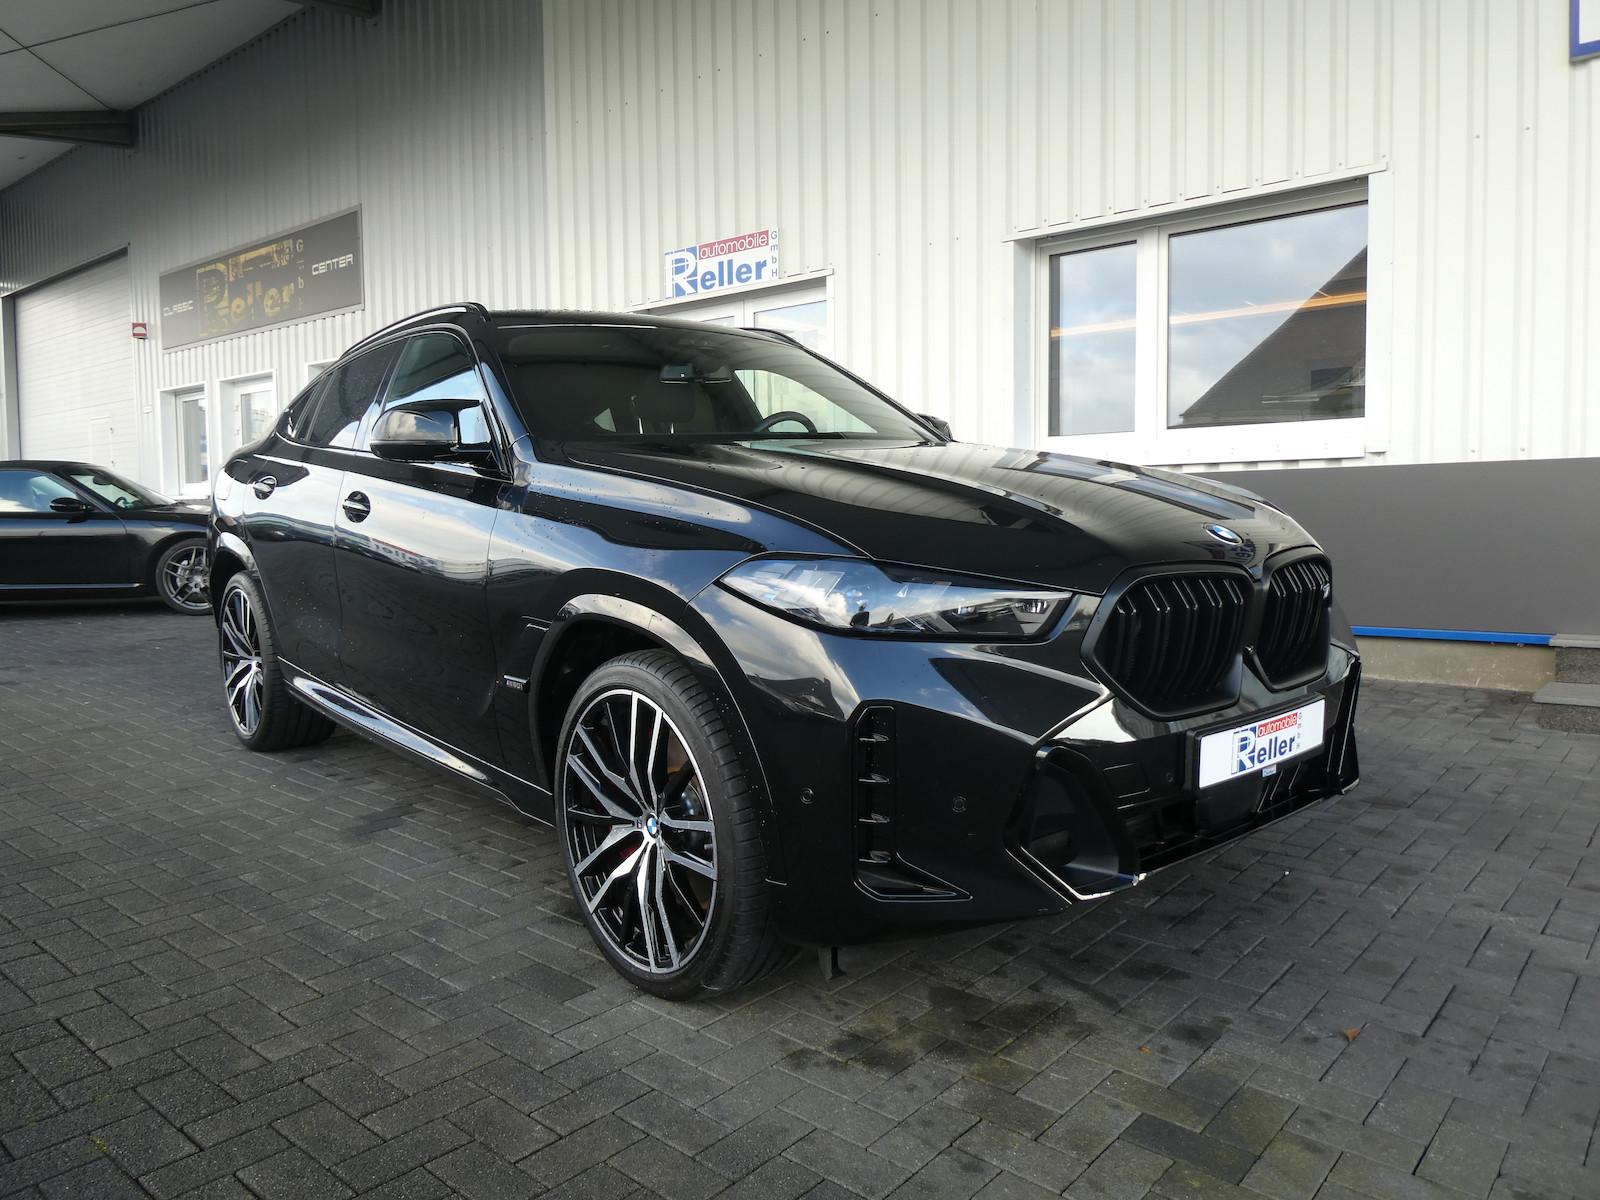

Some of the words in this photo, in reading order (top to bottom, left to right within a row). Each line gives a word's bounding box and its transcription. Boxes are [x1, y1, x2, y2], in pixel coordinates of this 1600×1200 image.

[700, 233, 768, 259] automobile
[770, 231, 778, 278] GmbH
[312, 254, 353, 275] CENTER
[665, 246, 767, 299] Reller
[1258, 713, 1298, 737] automobile
[1232, 726, 1295, 774] Reller
